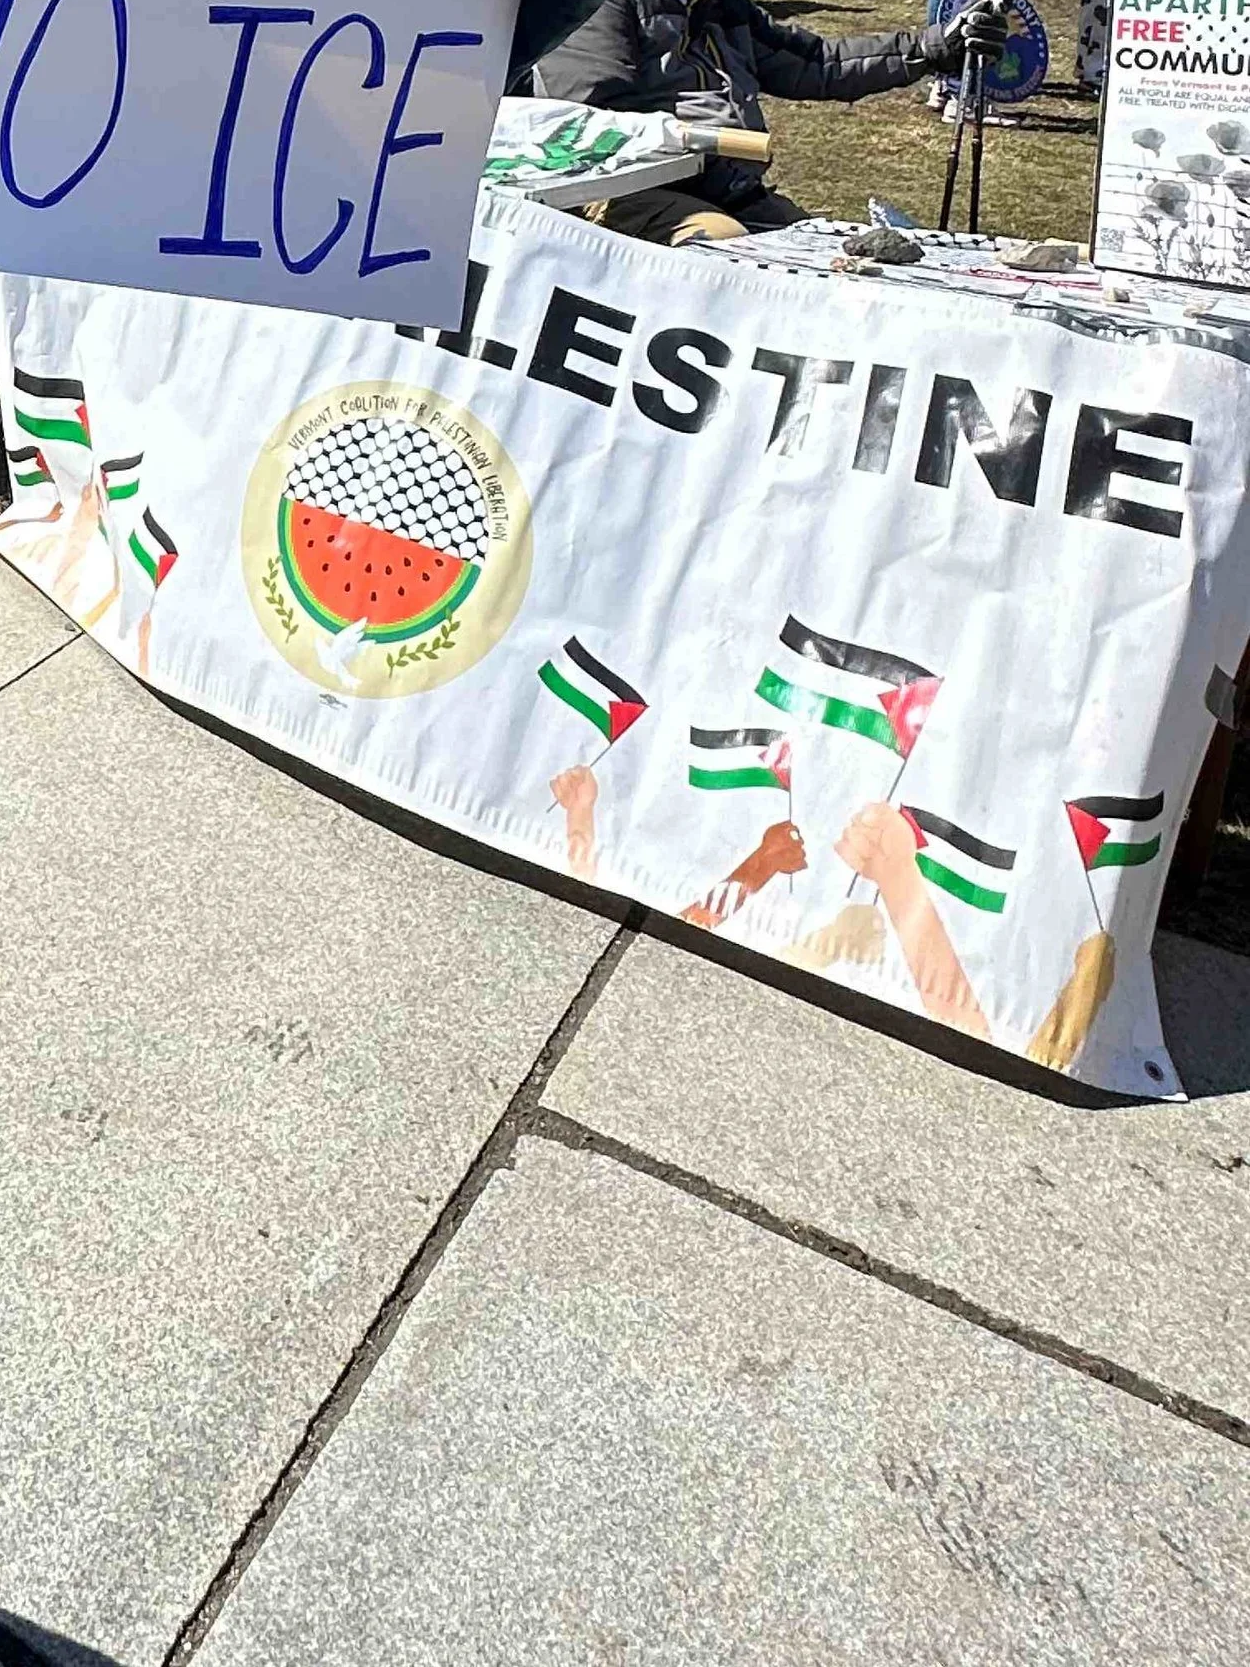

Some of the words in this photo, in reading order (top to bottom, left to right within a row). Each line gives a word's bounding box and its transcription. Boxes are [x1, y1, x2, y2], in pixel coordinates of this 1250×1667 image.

[1115, 47, 1250, 76] COMMU
[1117, 19, 1185, 43] FREE
[159, 5, 482, 278] ICE
[288, 406, 334, 451] VERMONT
[405, 398, 428, 417] FOR
[430, 411, 493, 470] PALESTINIAN
[395, 259, 1193, 539] LESTINE
